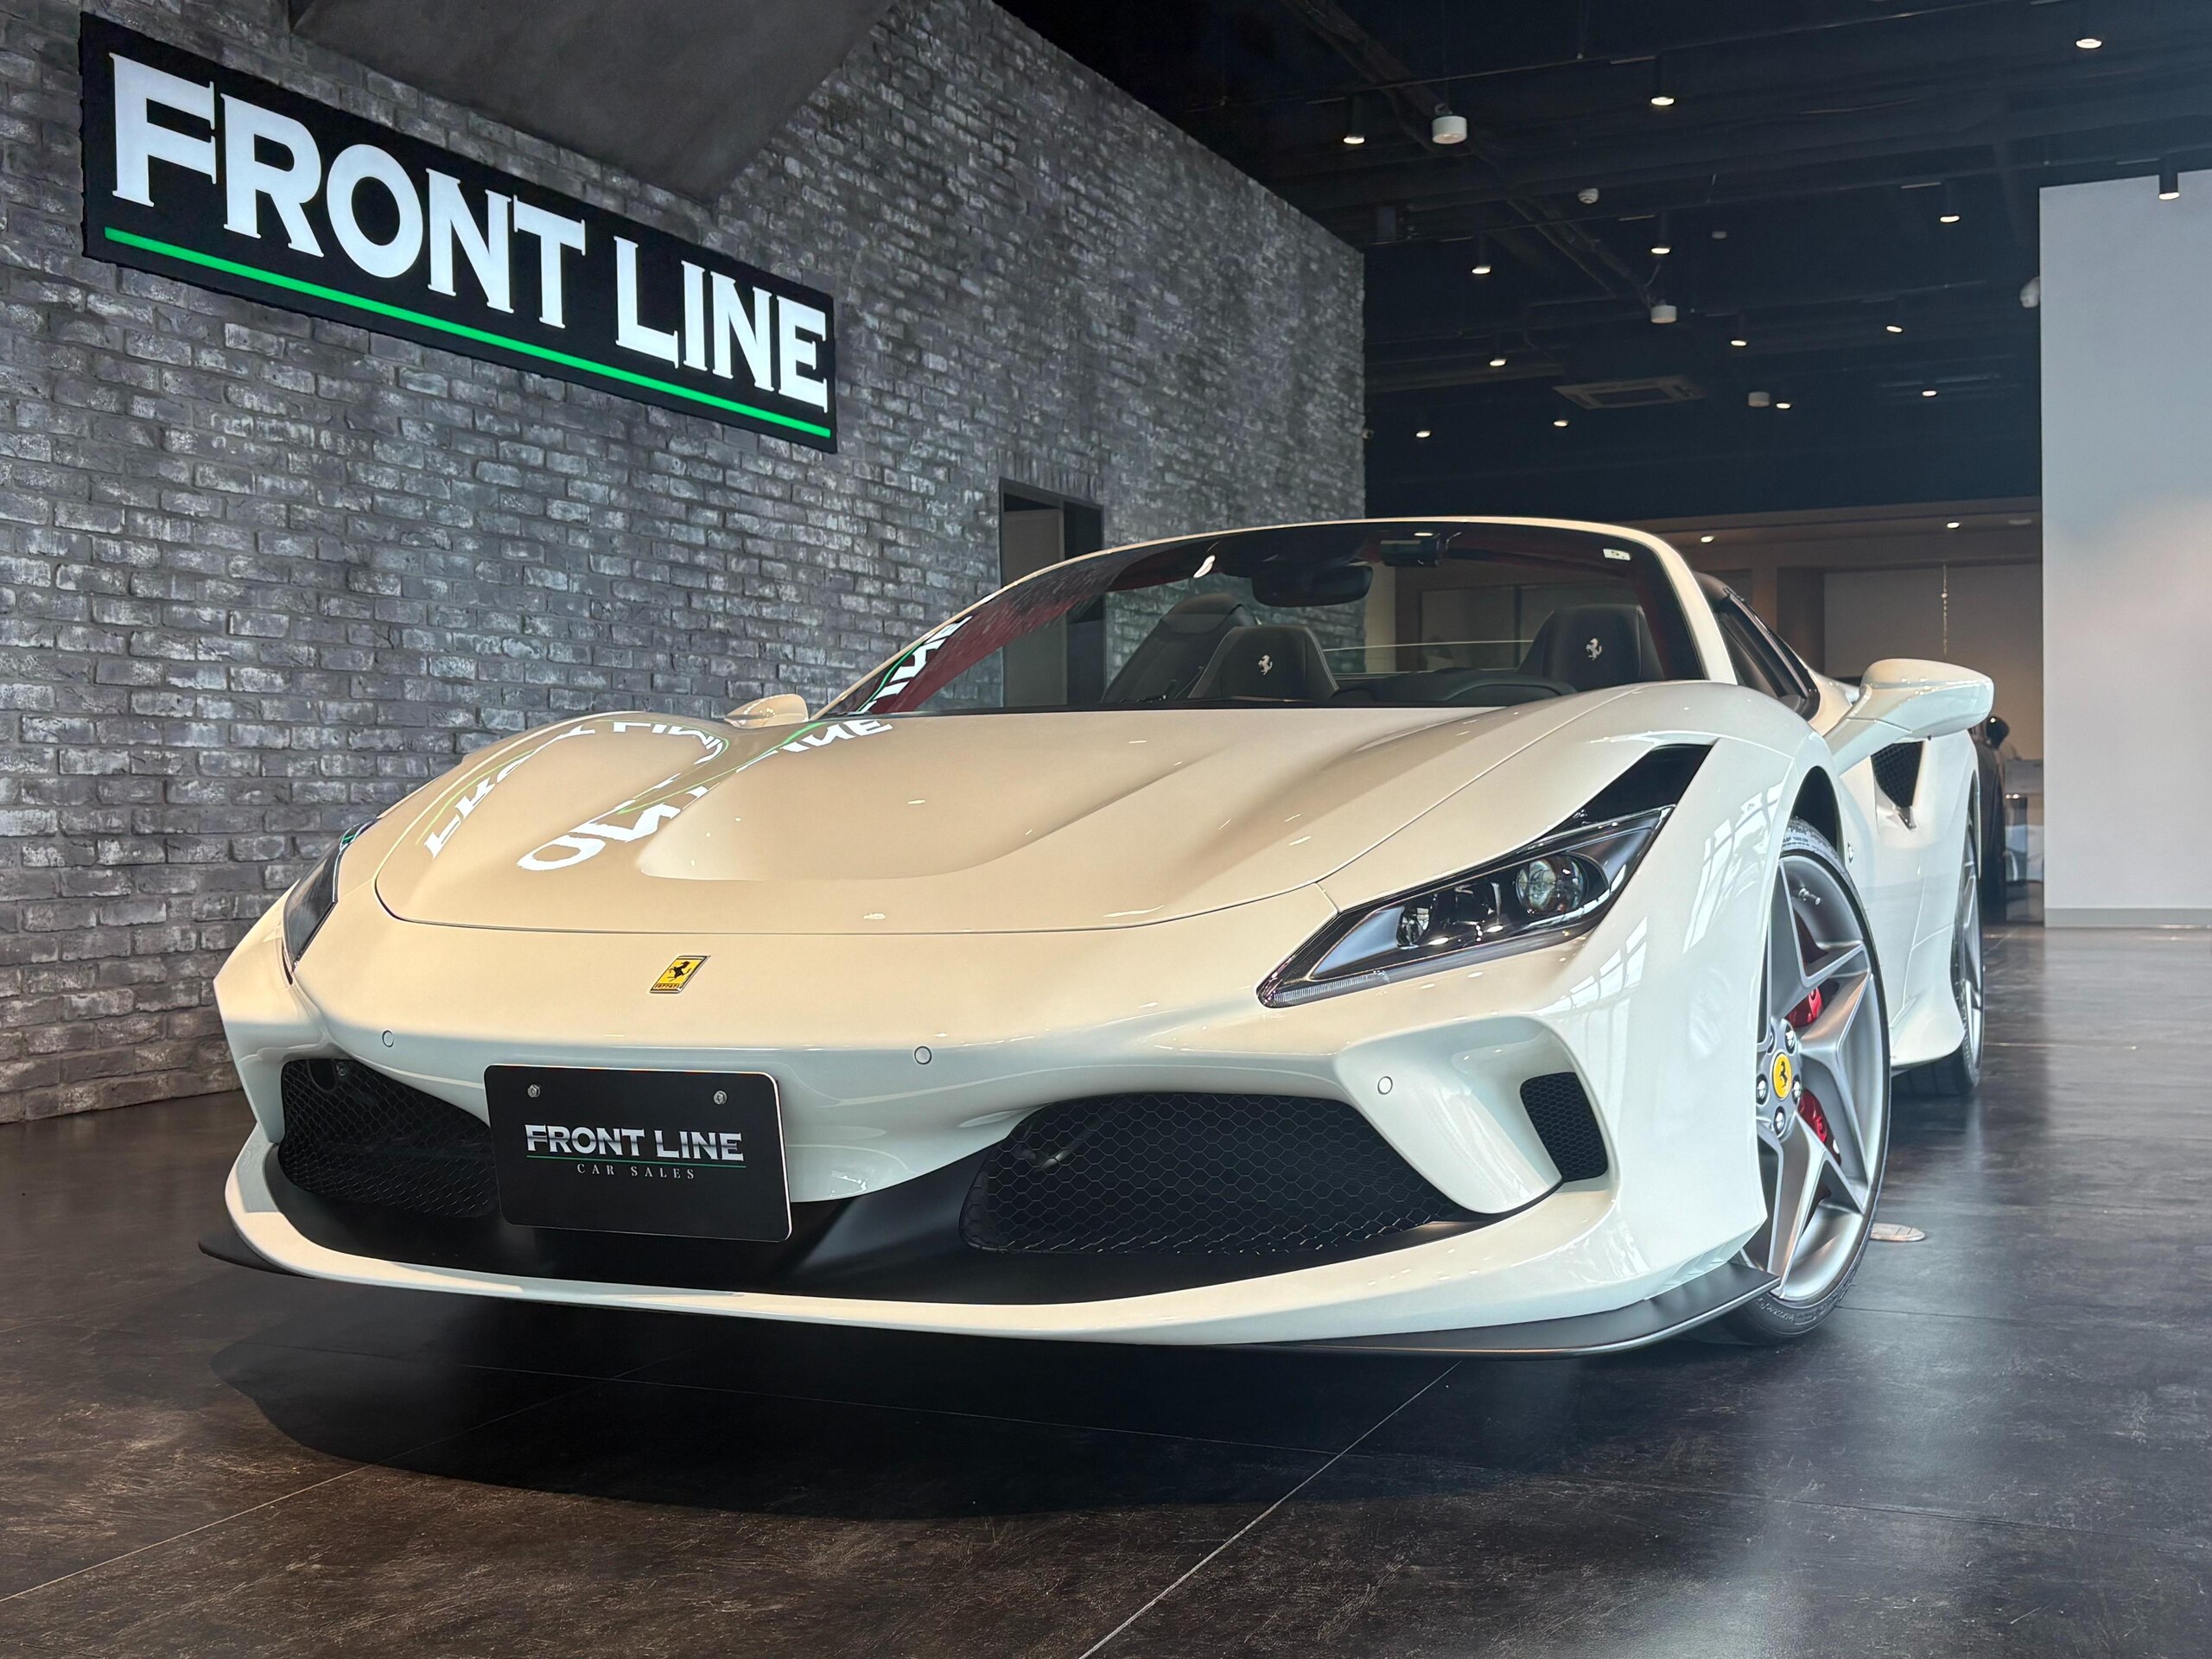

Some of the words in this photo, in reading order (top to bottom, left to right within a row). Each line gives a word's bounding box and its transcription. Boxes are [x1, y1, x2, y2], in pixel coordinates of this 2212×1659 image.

[110, 53, 586, 329] FRONT
[613, 235, 827, 414] LINE
[524, 1124, 645, 1156] FRONT
[654, 1128, 744, 1161] LINE
[576, 1163, 615, 1175] CAR
[630, 1166, 695, 1179] SALES
